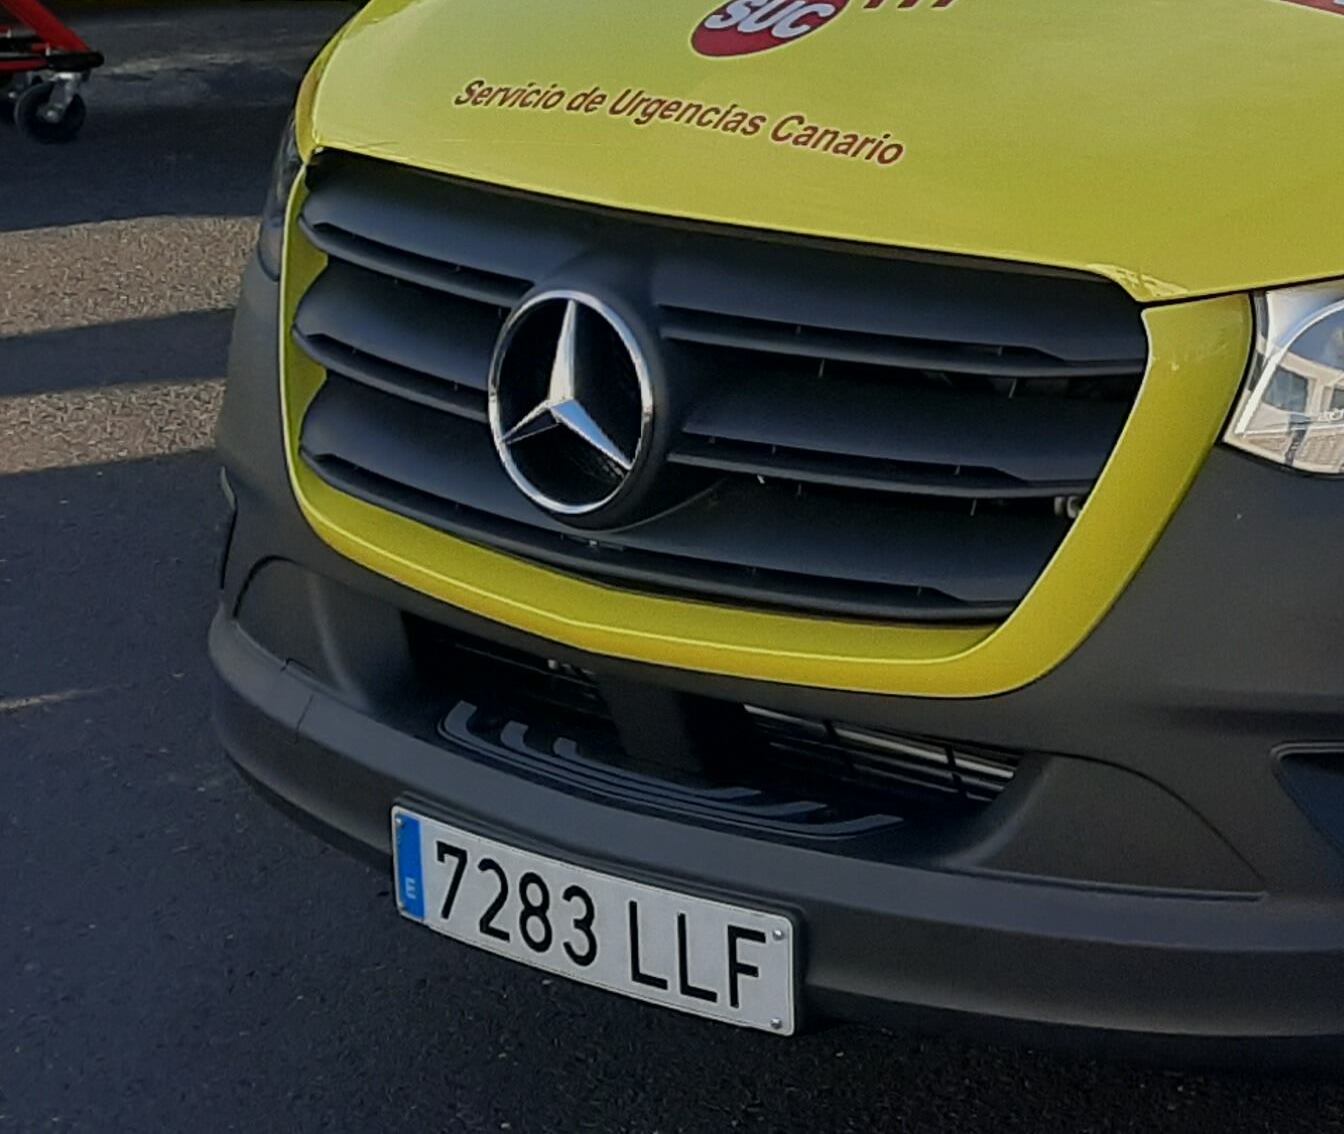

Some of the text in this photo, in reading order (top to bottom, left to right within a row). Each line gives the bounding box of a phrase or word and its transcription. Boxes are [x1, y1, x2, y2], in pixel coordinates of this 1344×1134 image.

[454, 79, 905, 166] Servicio de Urgencias Canario
[404, 876, 417, 900] E
[435, 840, 767, 1009] 7283 LLF
